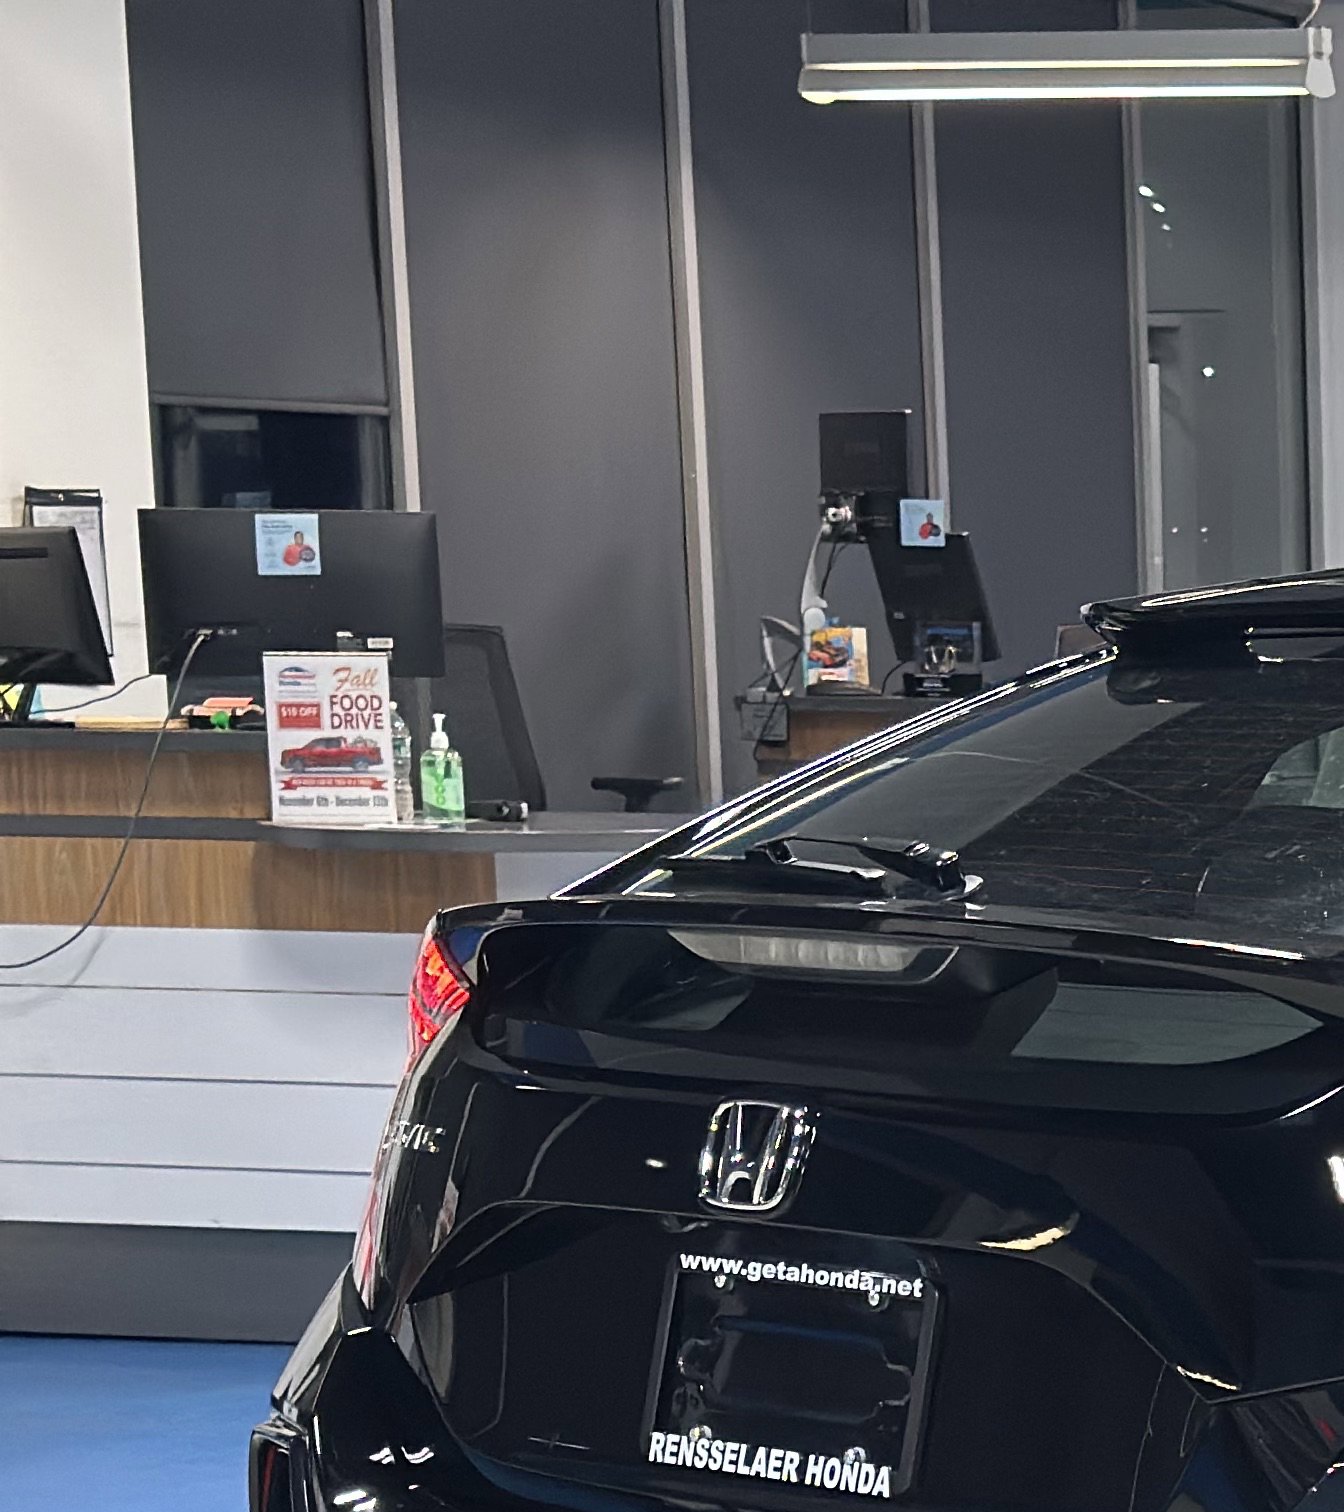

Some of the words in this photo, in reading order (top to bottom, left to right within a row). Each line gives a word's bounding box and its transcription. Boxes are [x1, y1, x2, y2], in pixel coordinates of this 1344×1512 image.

[333, 667, 378, 692] Fall
[330, 694, 383, 711] FOOD
[331, 712, 384, 730] DRIVE
[679, 1252, 924, 1298] www.getahonda.net
[647, 1431, 800, 1483] RENSSELAER
[804, 1454, 893, 1499] HONDA
